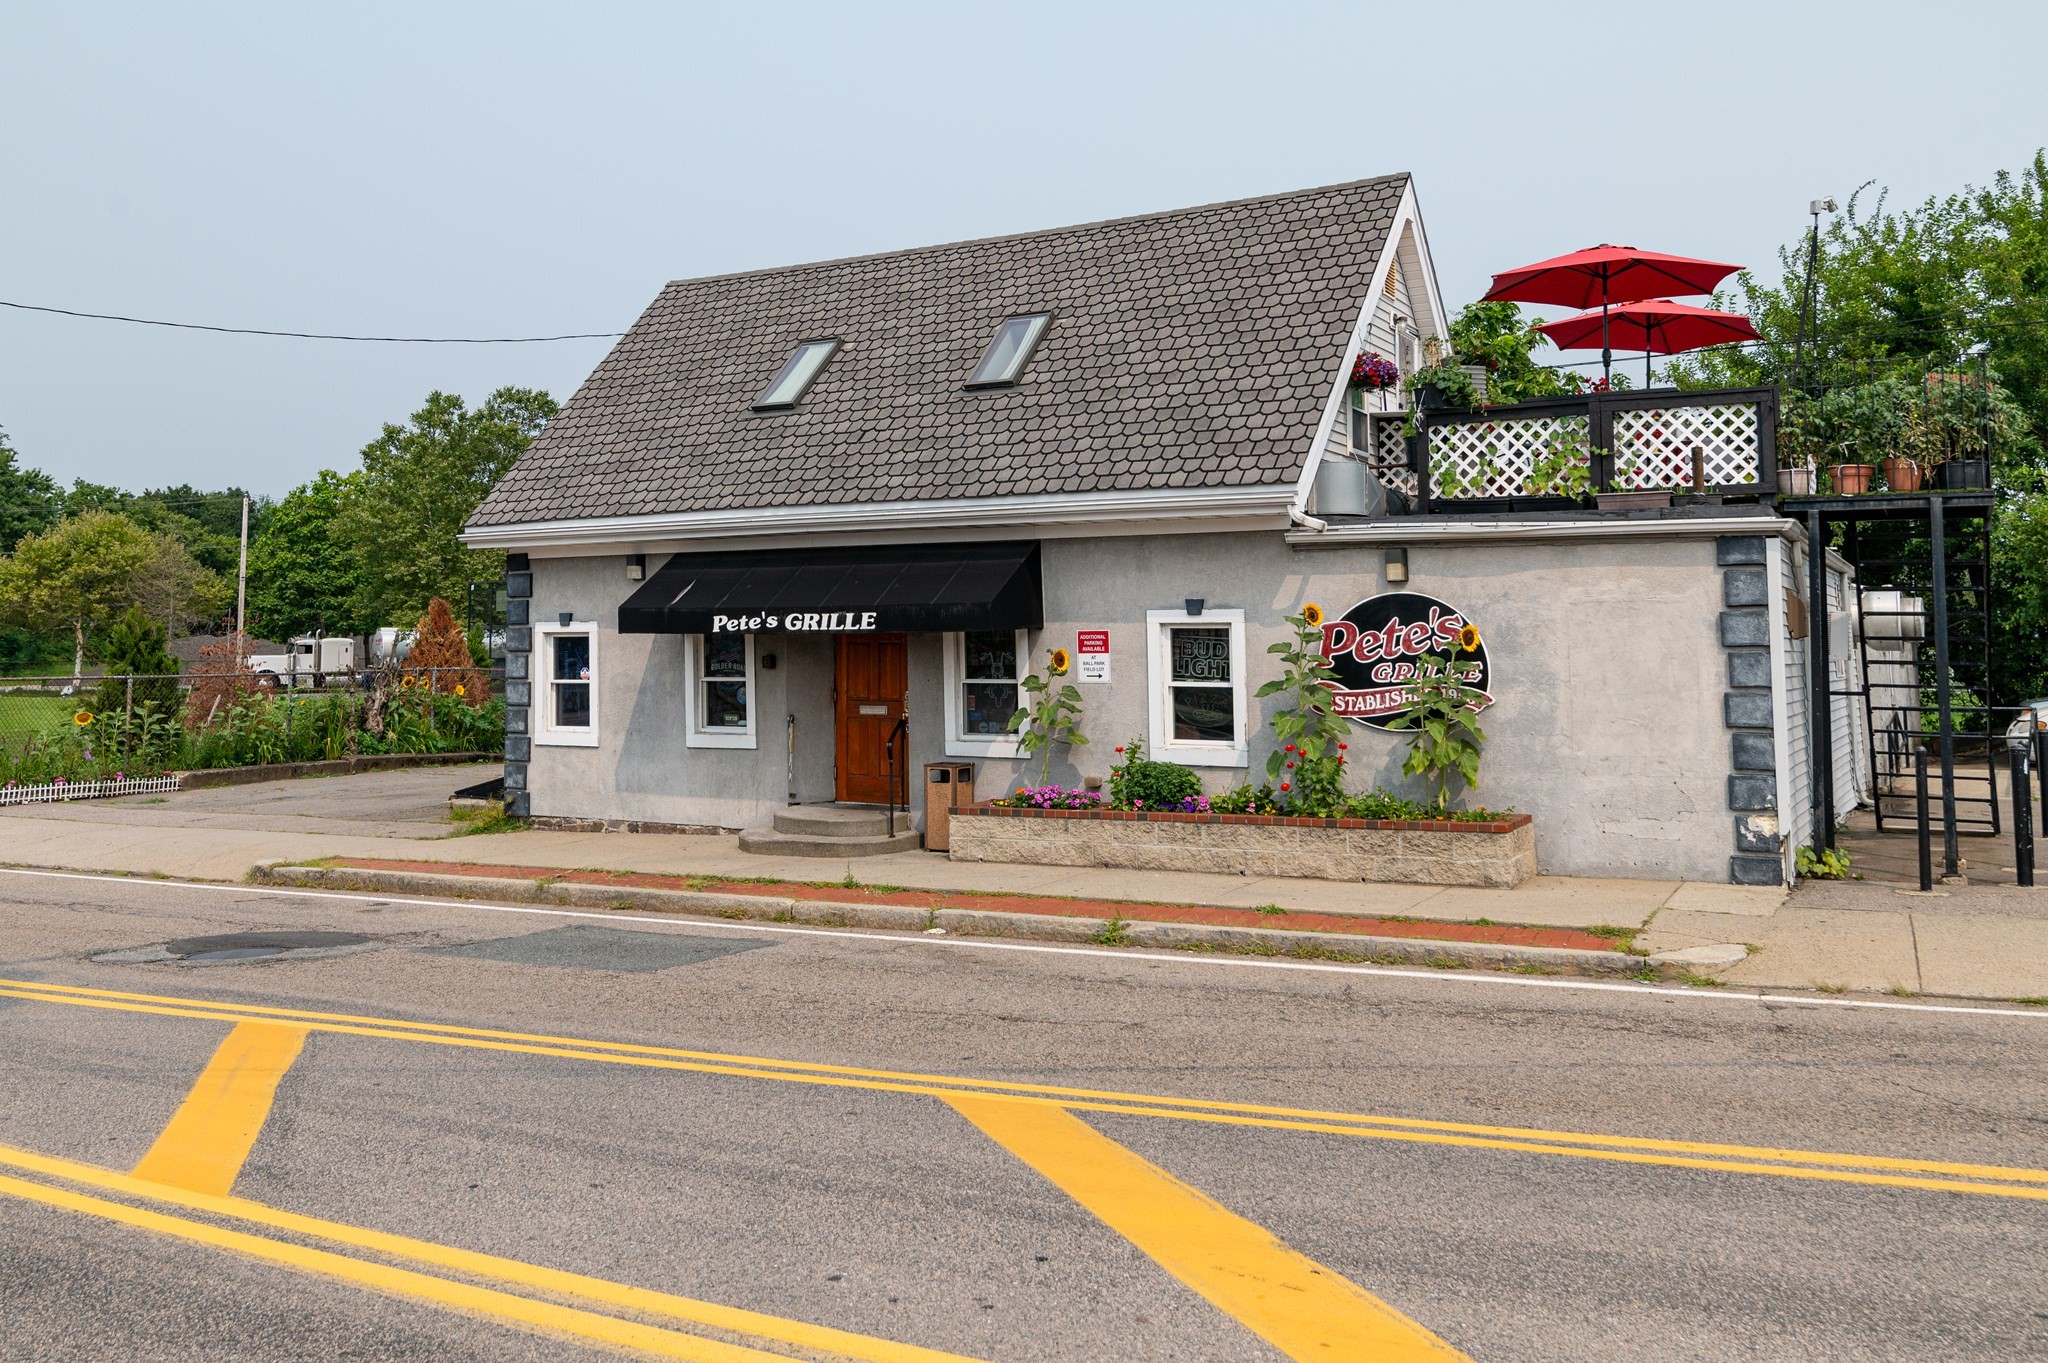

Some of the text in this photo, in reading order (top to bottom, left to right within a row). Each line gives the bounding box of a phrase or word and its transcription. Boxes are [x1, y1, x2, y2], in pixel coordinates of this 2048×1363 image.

[712, 611, 877, 632] Pete's GRILLE
[1315, 606, 1463, 668] Pete's
[1181, 640, 1228, 659] BUD
[1173, 658, 1230, 679] LIGHT
